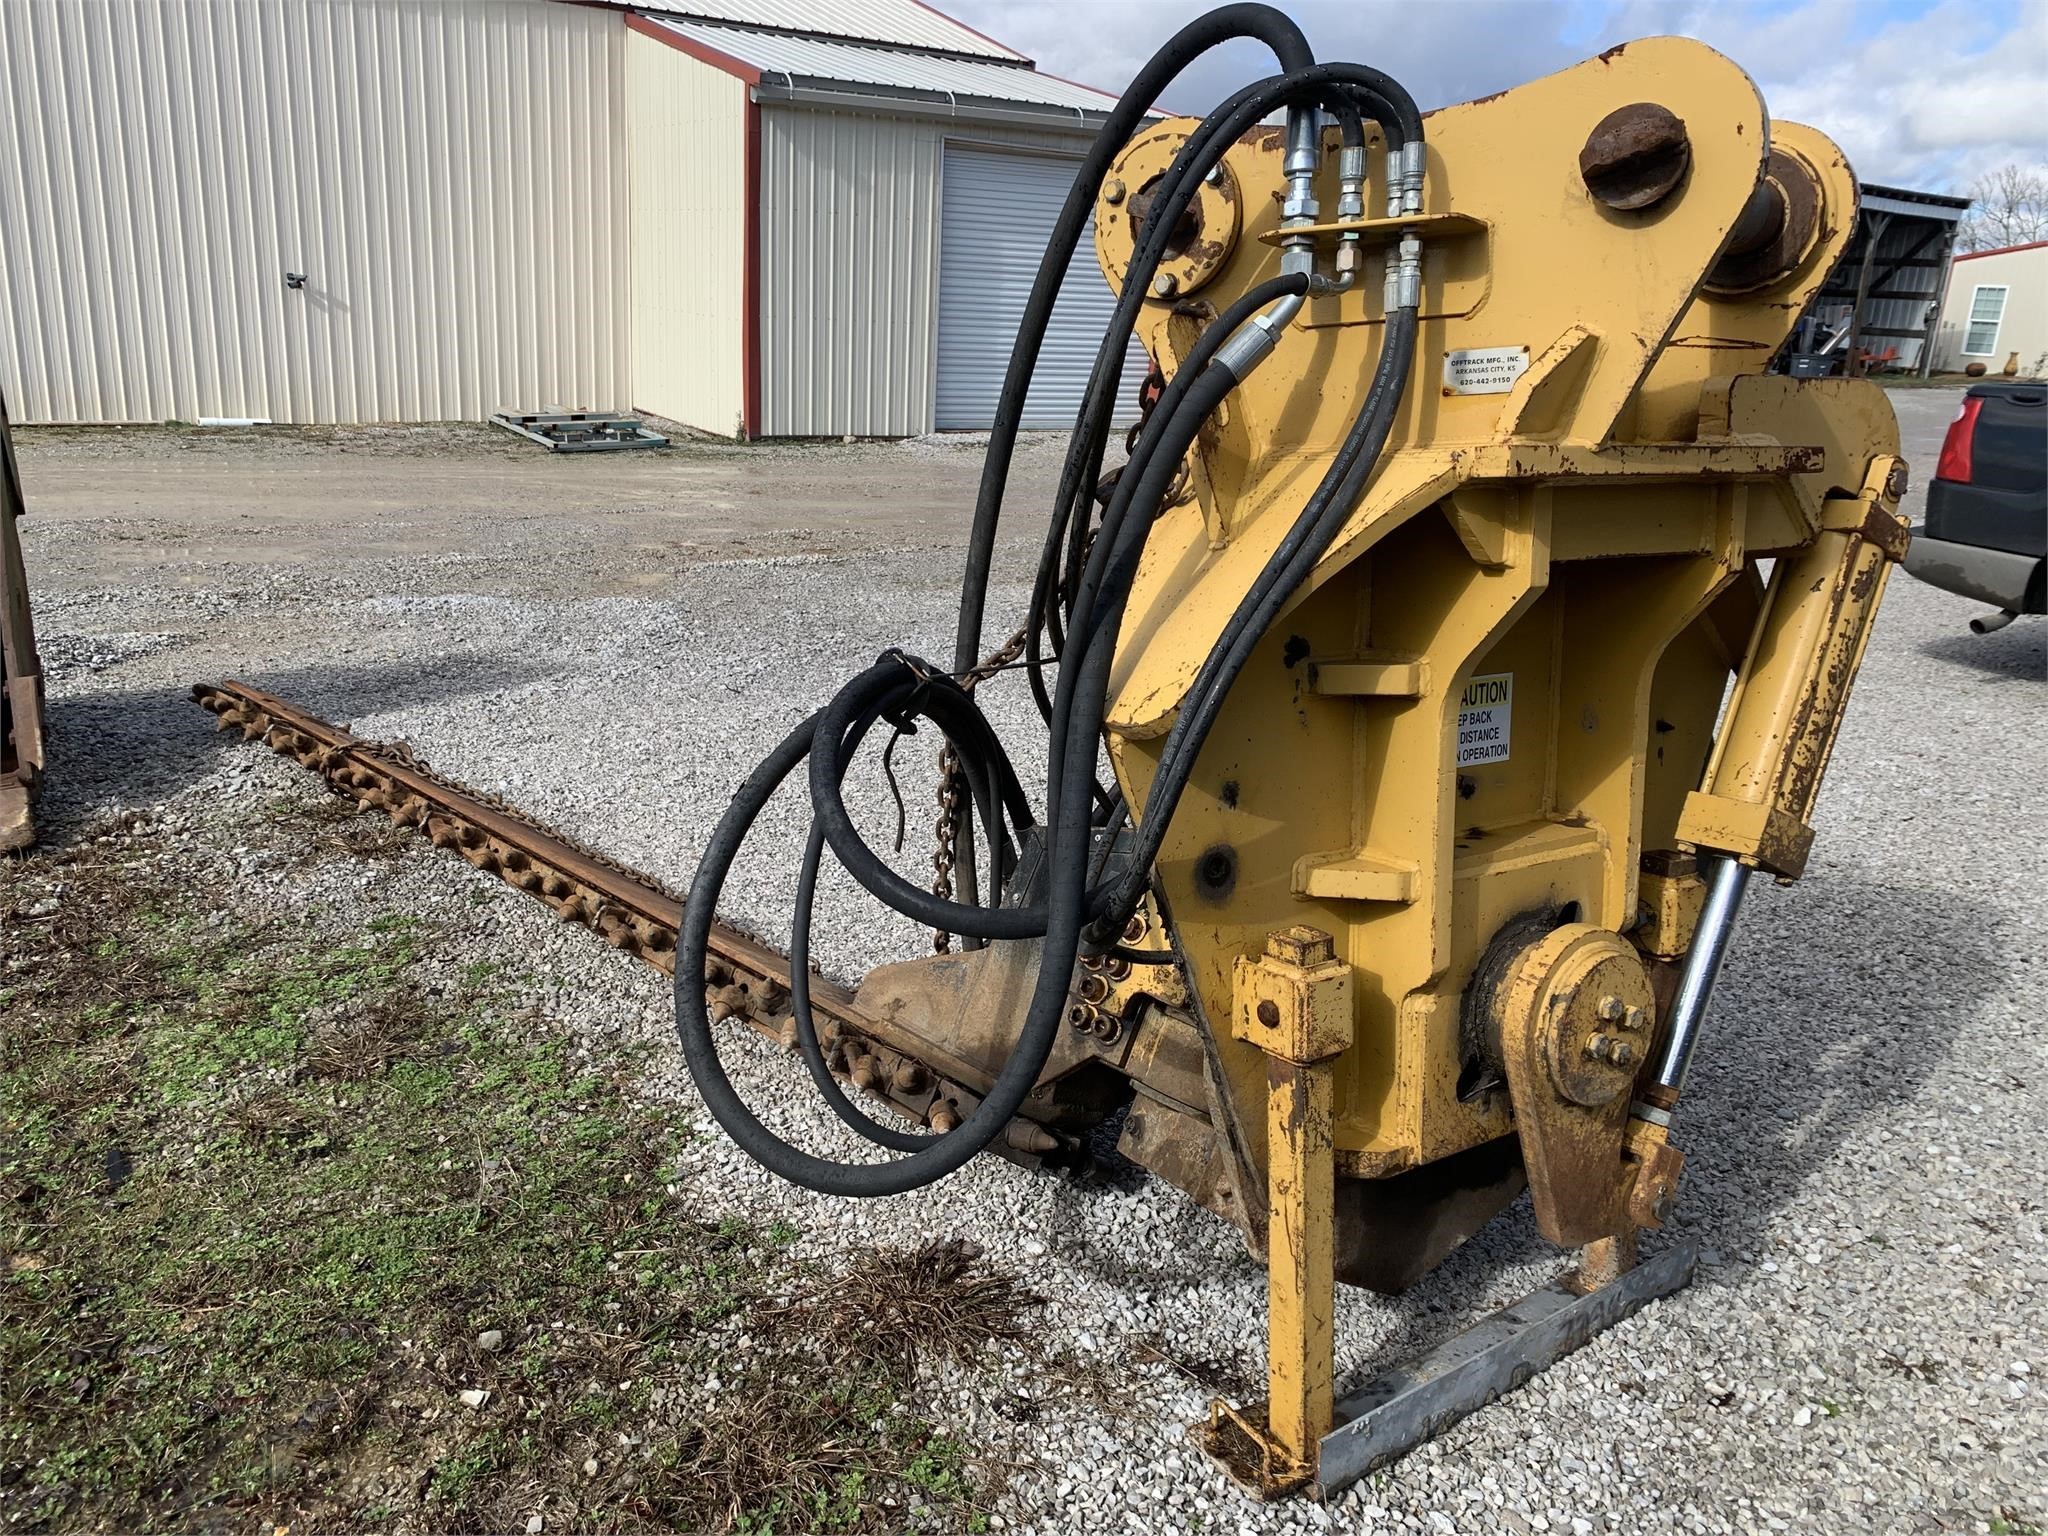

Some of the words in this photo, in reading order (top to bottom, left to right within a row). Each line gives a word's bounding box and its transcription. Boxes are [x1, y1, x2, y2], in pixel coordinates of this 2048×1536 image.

[1451, 358, 1485, 367] OFFTRACK
[1507, 355, 1521, 363] INC.
[1456, 367, 1489, 375] ARKANSAS
[1490, 365, 1506, 373] CITY,
[1460, 376, 1511, 386] 620-442-9150
[1460, 680, 1508, 707] AUTION
[1458, 713, 1468, 727] EP
[1470, 710, 1492, 725] BACK
[1460, 727, 1499, 744] DISTANCE
[1462, 744, 1508, 762] OPERATION
